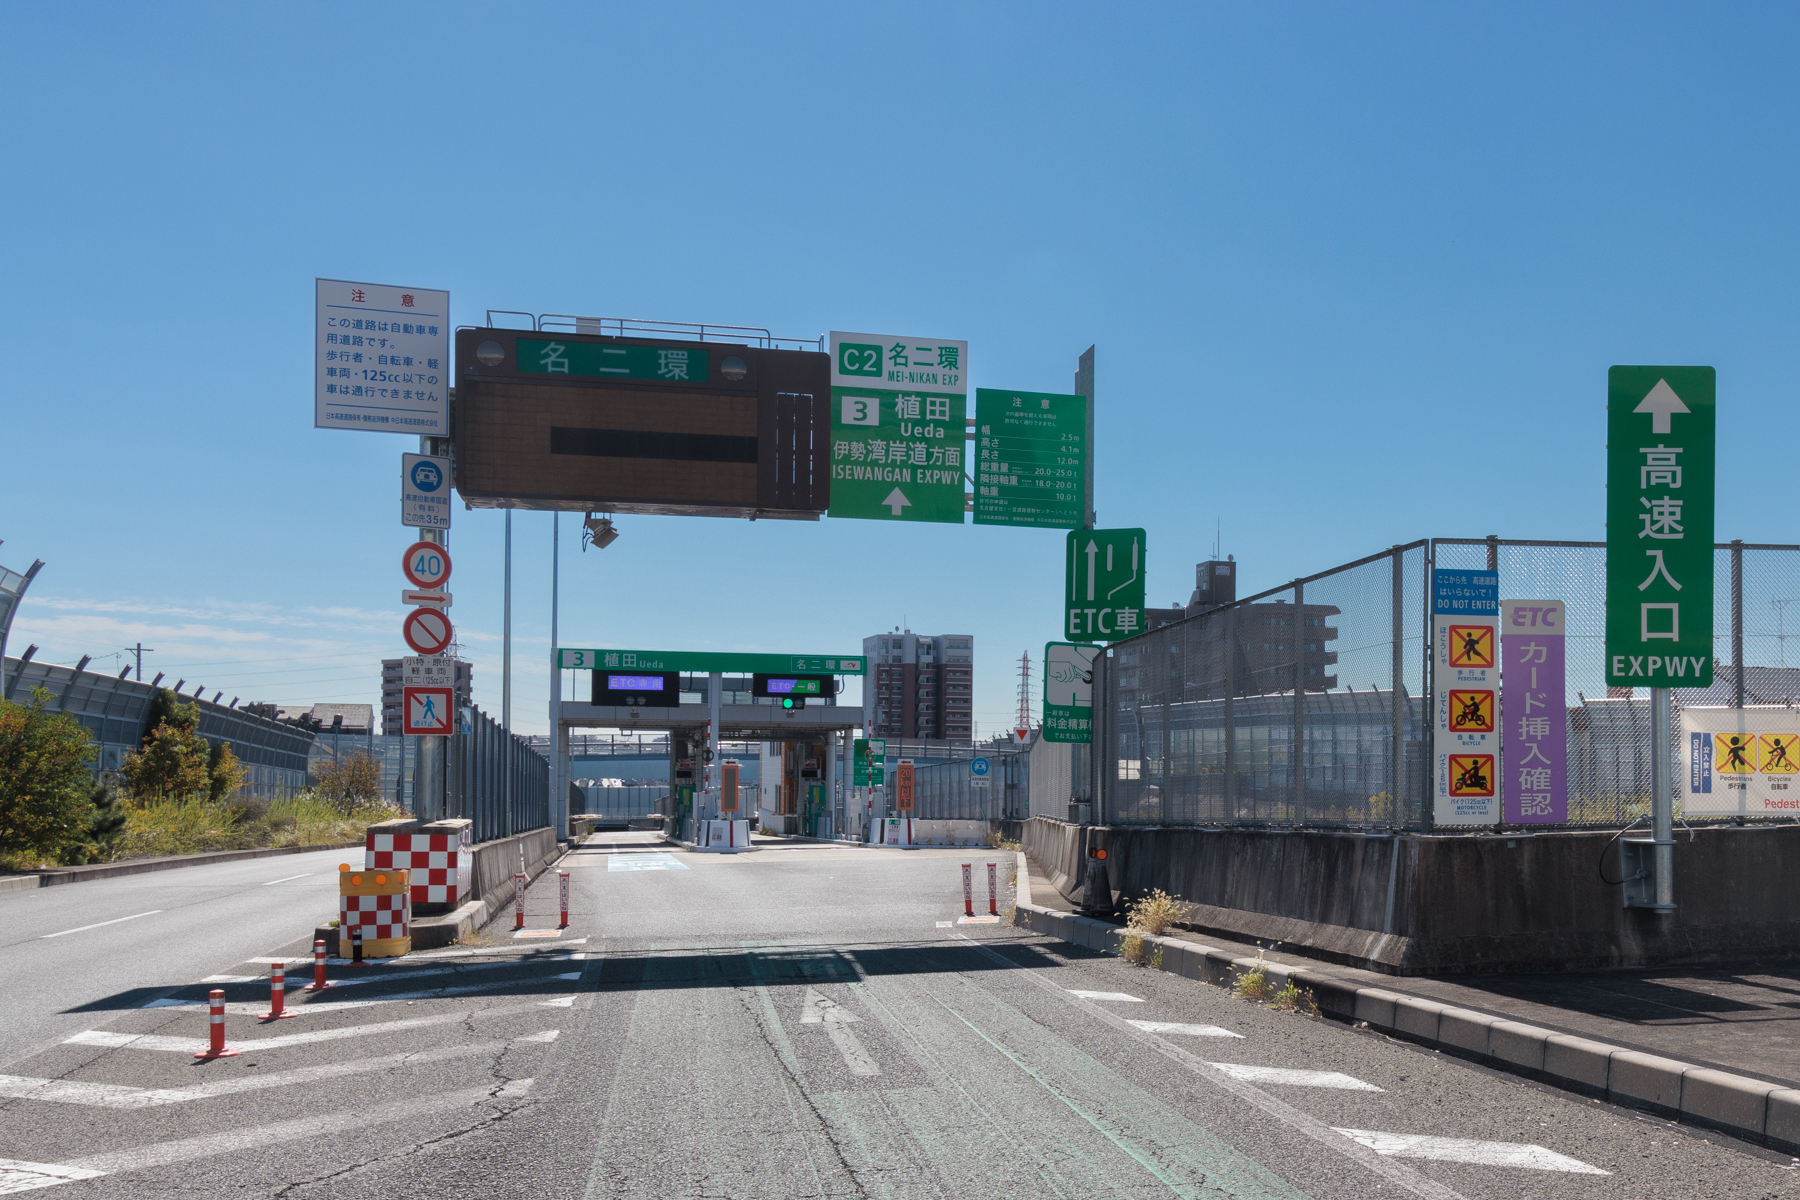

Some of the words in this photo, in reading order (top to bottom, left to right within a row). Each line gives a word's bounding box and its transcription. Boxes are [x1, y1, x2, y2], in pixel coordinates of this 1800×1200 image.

[351, 289, 415, 308] 注意
[328, 317, 439, 336] この道路は自動車専
[326, 333, 394, 350] 用道路です。
[326, 350, 439, 370] 歩行者・自転車・軽
[540, 342, 690, 380] 名二環
[844, 348, 877, 372] C2
[888, 342, 960, 371] 名二環
[326, 367, 438, 385] 車両・125cc以下の
[888, 370, 938, 385] MEI-NIKAN
[942, 374, 959, 386] EXP
[326, 383, 438, 402] 車は通行できません
[852, 400, 868, 422] 3
[894, 394, 950, 422] 植田
[1012, 397, 1050, 410] 注意
[900, 422, 944, 438] Ueda
[981, 425, 990, 436] 幅
[1060, 433, 1080, 442] 2.5m
[833, 439, 961, 467] 伊勢湾岸道方面
[980, 437, 999, 448] 高さ
[1060, 446, 1080, 454] 4.1m
[980, 449, 999, 460] 長さ
[1056, 457, 1079, 466] 12.0m
[832, 464, 911, 482] ISEWANGAN
[917, 469, 962, 486] EXPWY
[980, 461, 1010, 473] 総重量
[406, 512, 448, 526] この先35m
[1637, 444, 1684, 642] 高速入口
[414, 555, 440, 576] 40
[1437, 575, 1467, 585] ここから先
[1472, 576, 1497, 586] 高速道路
[1439, 588, 1492, 598] はいらないで！
[1437, 599, 1450, 609] DO
[1452, 600, 1468, 609] NOT
[1471, 600, 1496, 610] ENTER
[1069, 606, 1139, 634] ETC車
[1510, 606, 1557, 627] ETC
[406, 658, 452, 667] 小特・原付
[573, 652, 584, 666] 3
[604, 652, 636, 668] 植田
[640, 660, 664, 669] Ueda
[796, 659, 836, 670] 名二環
[1612, 656, 1706, 678] EXPWY
[412, 667, 447, 676] 軽車両
[1457, 669, 1486, 677] 歩行者
[1518, 642, 1554, 816] カード挿入確認
[1693, 739, 1699, 749] DO
